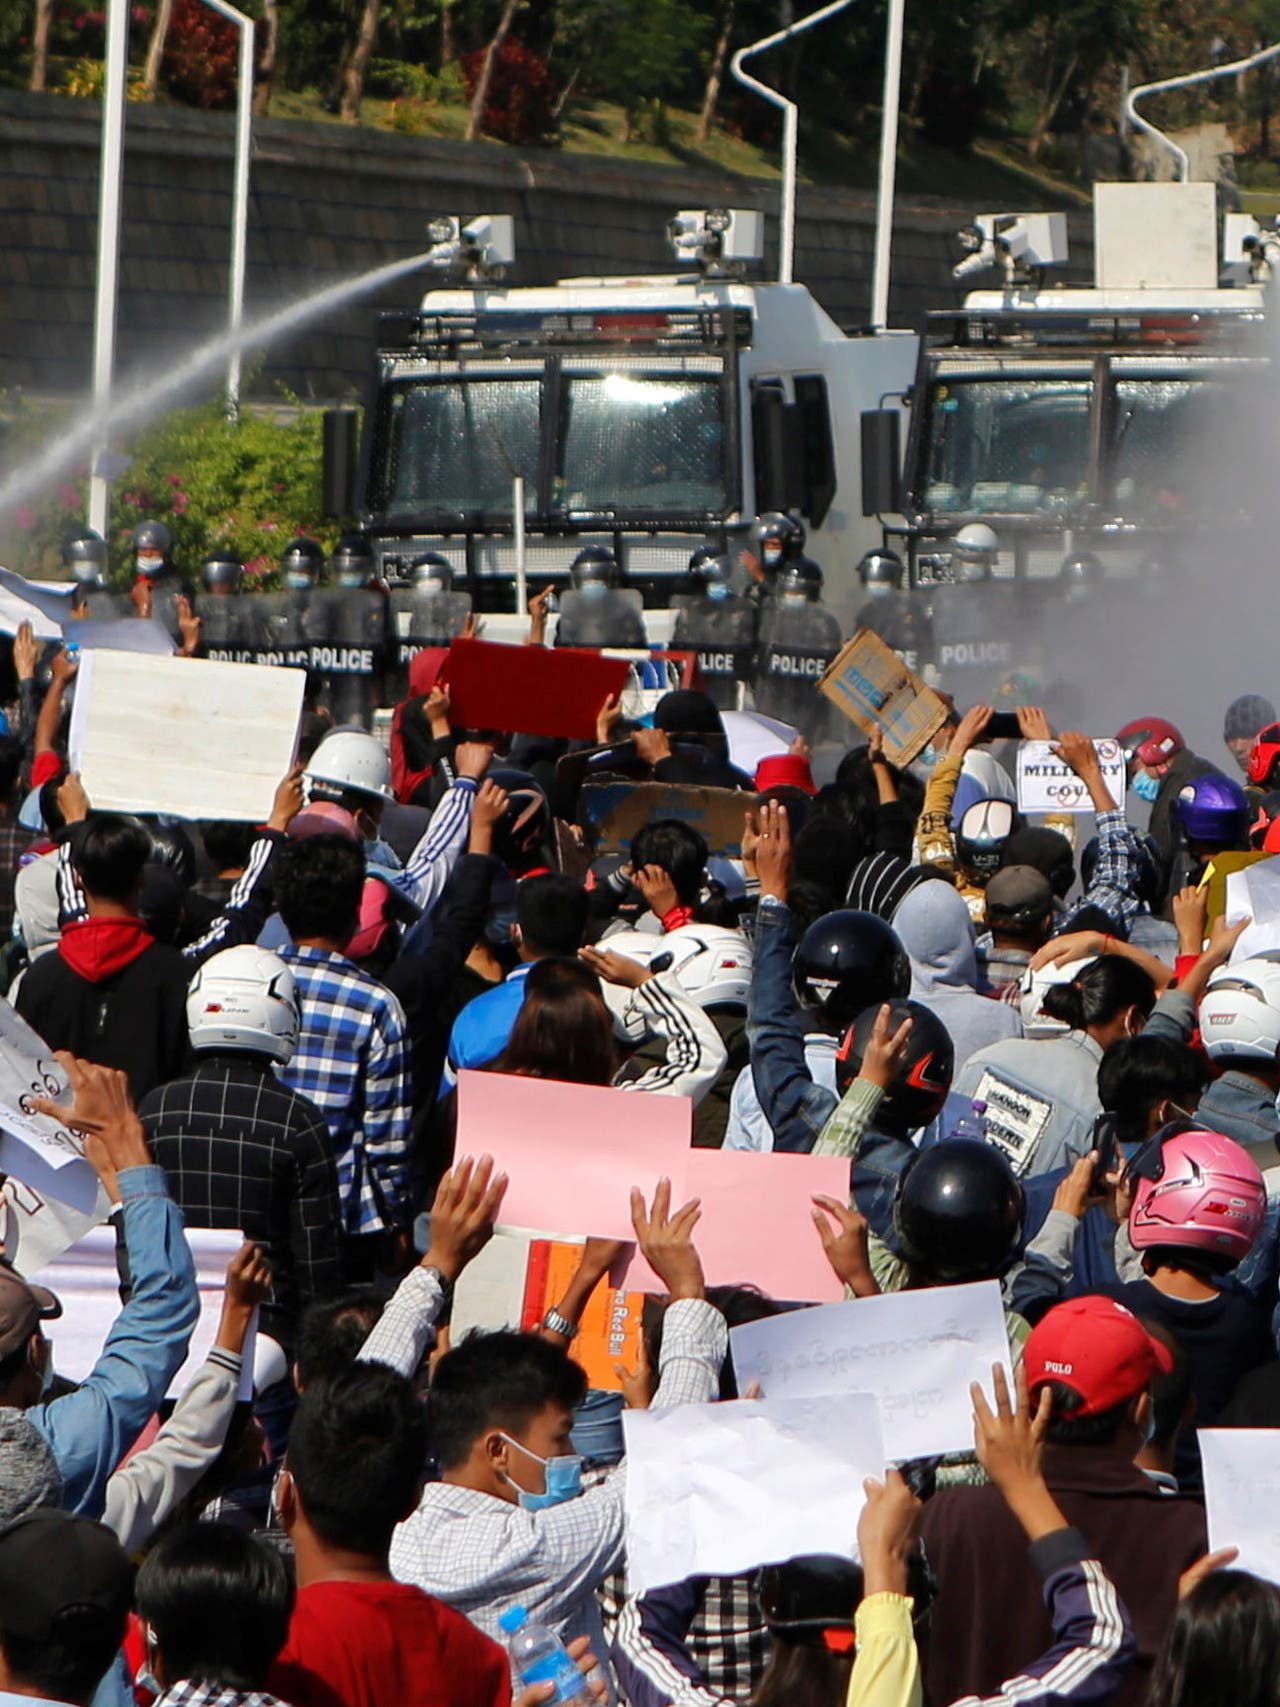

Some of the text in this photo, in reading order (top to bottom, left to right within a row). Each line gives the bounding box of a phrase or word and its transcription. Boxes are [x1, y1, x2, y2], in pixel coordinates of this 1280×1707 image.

[208, 649, 252, 664] POLIC
[312, 647, 373, 670] POLICE
[698, 653, 734, 671] LICE
[941, 642, 1011, 665] POLICE
[771, 653, 826, 675] POLICE
[1024, 764, 1120, 777] MILIRY
[1047, 785, 1090, 797] COU
[611, 1306, 628, 1331] Red
[608, 1333, 625, 1355] Bull
[1045, 1361, 1072, 1375] POLO
